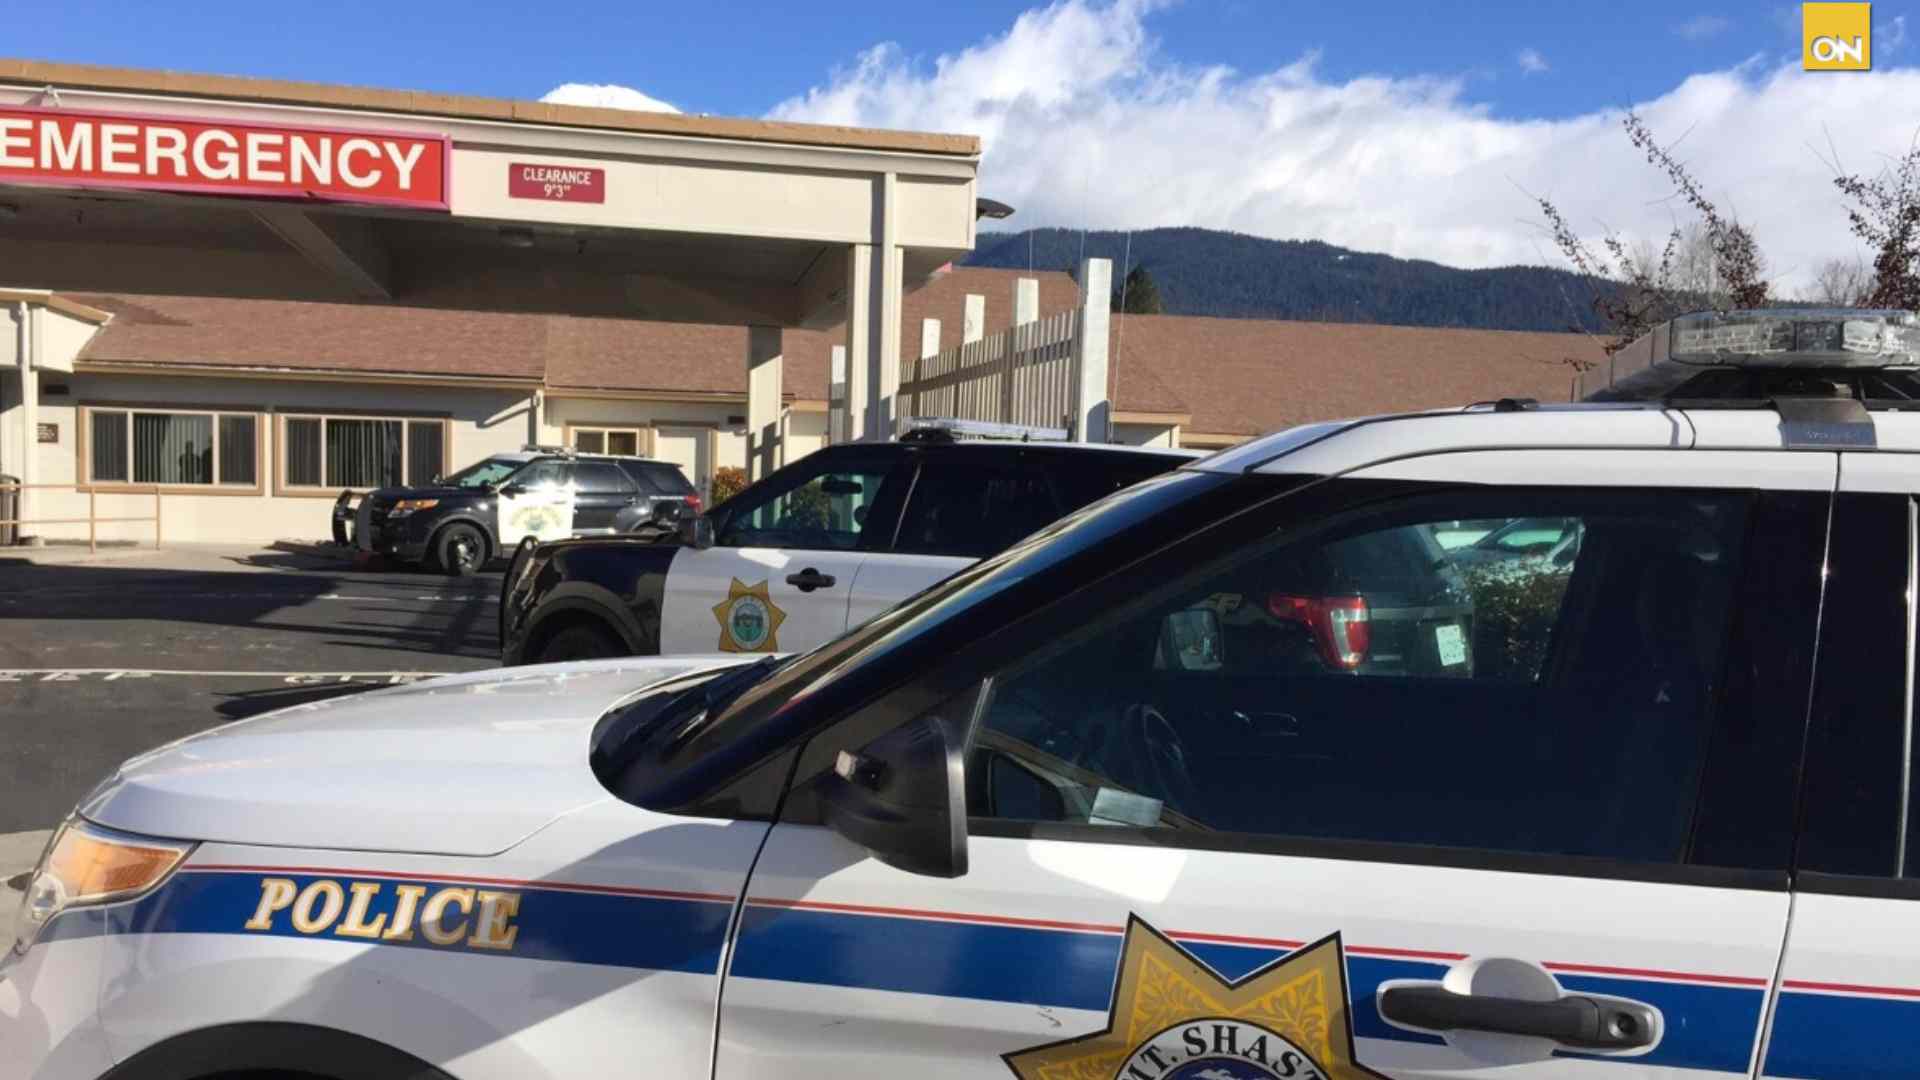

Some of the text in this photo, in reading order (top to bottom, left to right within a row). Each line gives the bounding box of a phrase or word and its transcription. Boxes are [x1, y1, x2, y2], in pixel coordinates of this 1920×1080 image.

[0, 118, 425, 190] EMERGENCY
[523, 167, 592, 185] CLEARANCE
[245, 878, 521, 950] POLICE
